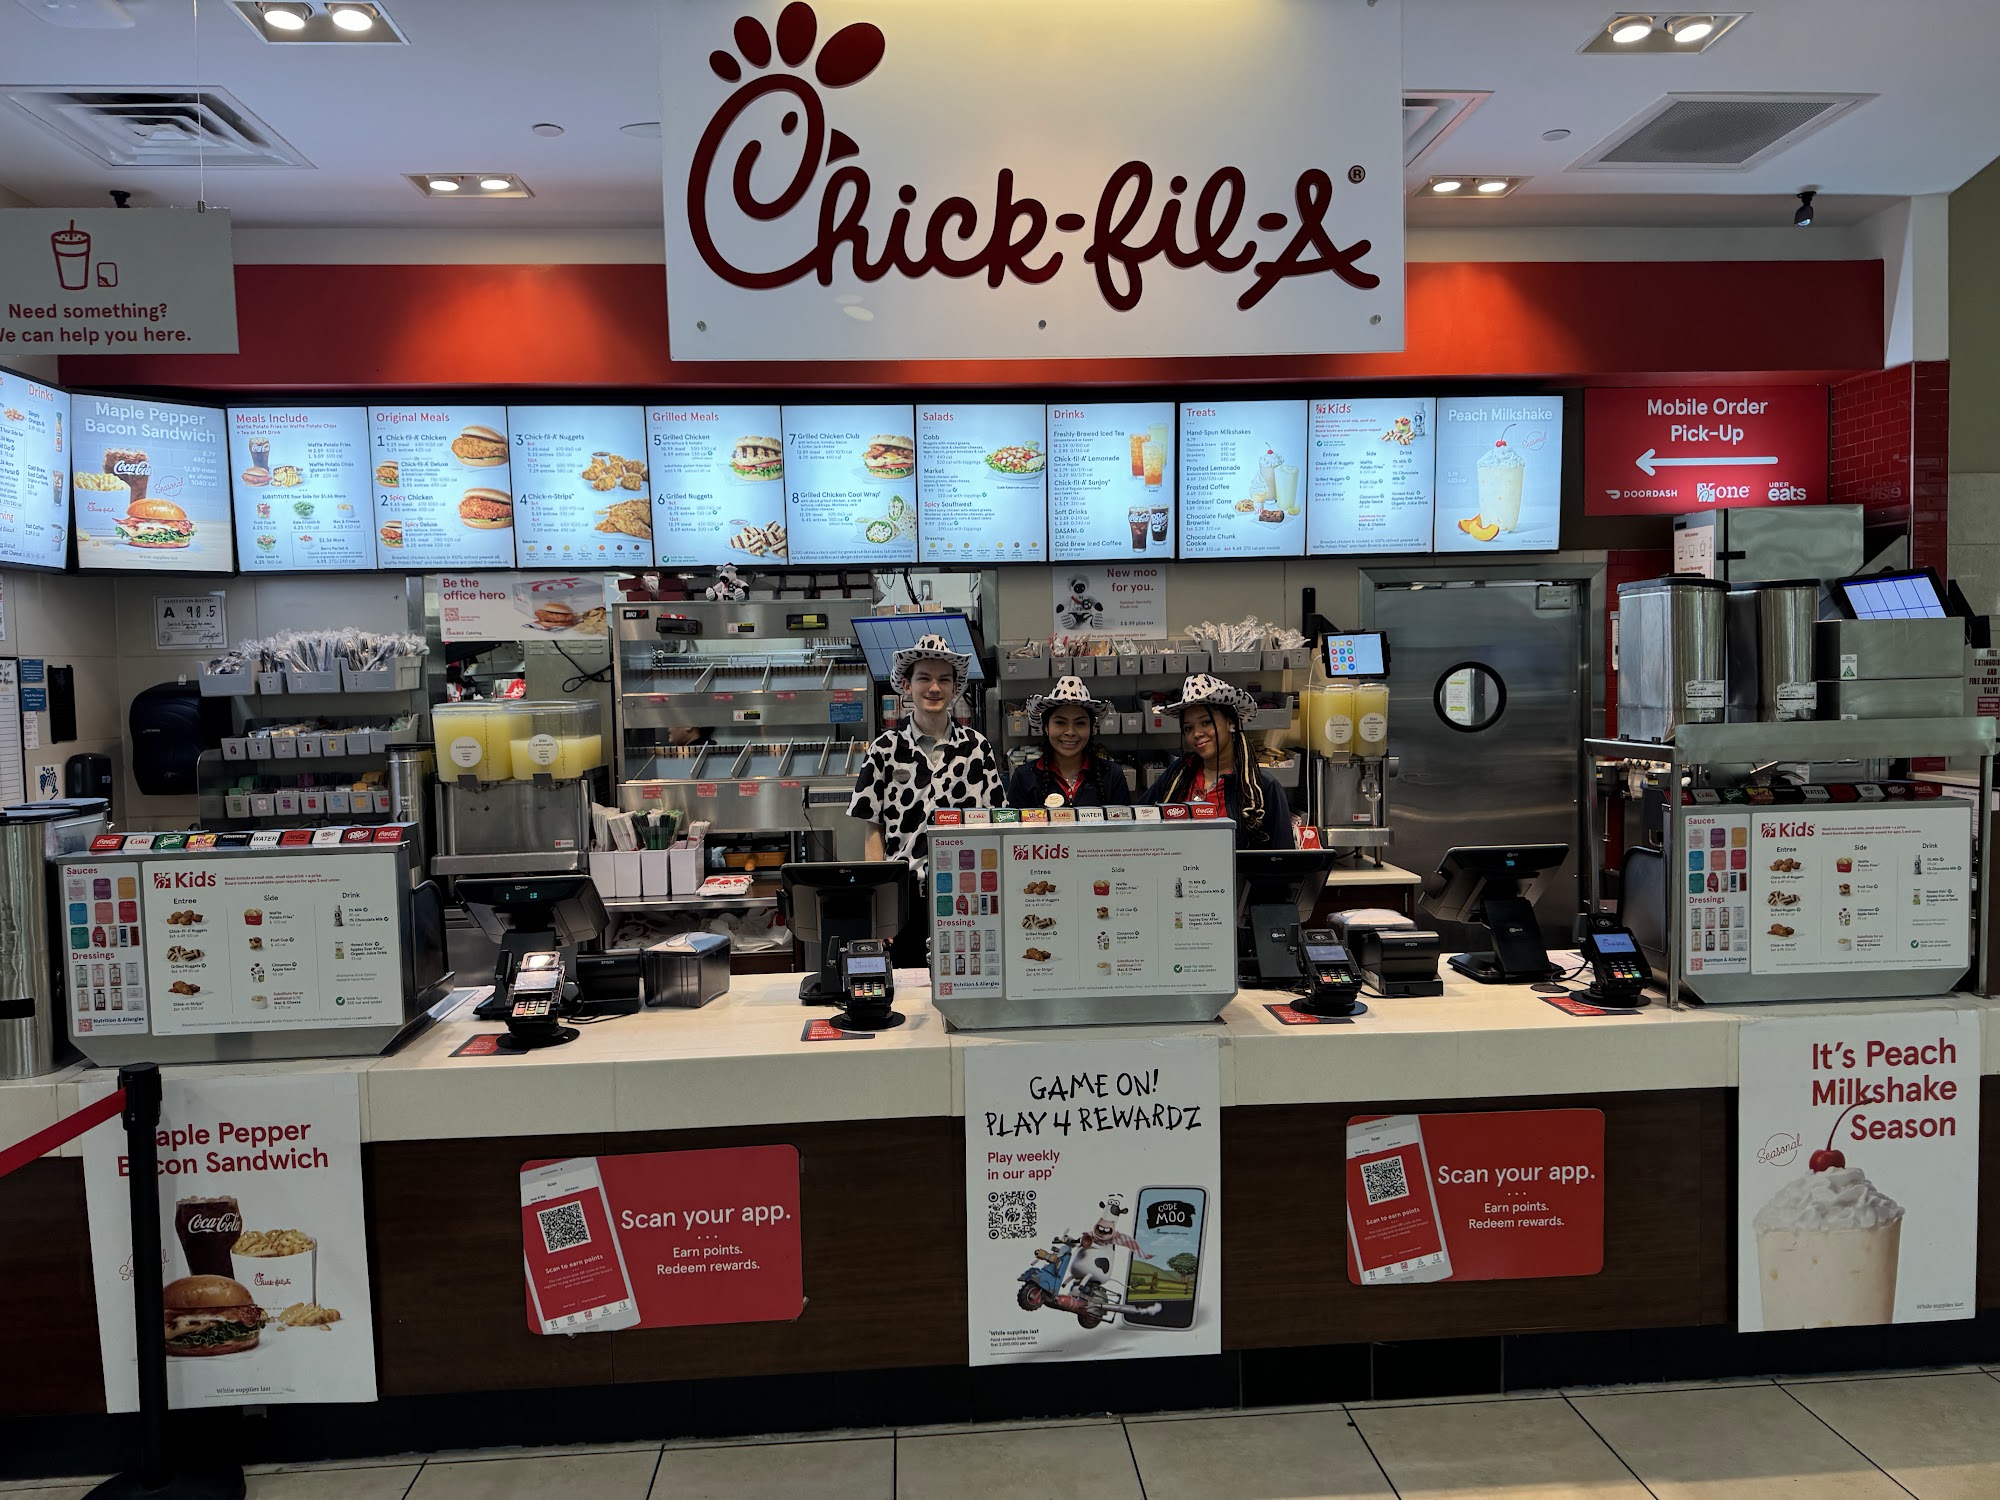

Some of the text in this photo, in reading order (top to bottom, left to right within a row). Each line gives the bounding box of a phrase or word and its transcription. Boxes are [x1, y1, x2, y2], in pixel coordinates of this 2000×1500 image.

[8, 302, 168, 322] Need something?
[21, 329, 54, 342] can
[59, 327, 100, 346] help
[104, 330, 138, 346] you
[143, 326, 192, 342] here.
[28, 383, 54, 402] Drinks
[1186, 408, 1216, 417] Treats
[1327, 403, 1350, 414] Kids
[1647, 397, 1769, 416] Mobile Order
[95, 401, 206, 428] Maple Pepper
[236, 413, 309, 423] Meals Include
[376, 412, 450, 425] Original Meals
[652, 411, 720, 422] Grilled Meals
[922, 411, 954, 421] Salads
[1053, 409, 1085, 419] Drinks
[1448, 407, 1553, 422] Peach Milkshake
[84, 418, 216, 443] Bacon Sandwich
[1053, 430, 1099, 438] Freshly-Brewed
[1219, 428, 1251, 436] Milkshakes
[1670, 423, 1745, 445] Pick-Up
[653, 434, 662, 446] 5
[788, 433, 797, 445] 7
[845, 432, 861, 440] Club
[113, 460, 151, 476] Coca-Cola
[1209, 464, 1241, 472] Lemonade
[791, 492, 800, 504] 8
[800, 491, 821, 499] Grilled
[821, 491, 847, 499] Chicken
[1623, 489, 1678, 499] DOORDASH
[1715, 485, 1749, 499] one
[1767, 485, 1807, 501] eats
[380, 494, 389, 507] 2
[389, 494, 406, 502] Spicy
[519, 493, 528, 506] 4
[657, 493, 666, 506] 6
[688, 493, 713, 501] Nuggets
[1217, 513, 1235, 521] Fudge
[1186, 533, 1236, 541] Chocolate Chunk
[1106, 568, 1158, 578] New moo
[442, 577, 480, 588] Be the
[1111, 582, 1154, 594] for you.
[443, 590, 506, 601] office hero
[163, 606, 176, 618] A
[1688, 816, 1716, 826] Sauces
[1779, 821, 1814, 838] Kids
[129, 837, 151, 846] Coke
[253, 835, 278, 843] WATER
[935, 838, 964, 847] Sauces
[1032, 843, 1069, 860] Kids
[1854, 844, 1868, 852] Side
[66, 866, 98, 876] Sauces
[174, 871, 216, 889] Kids
[173, 897, 197, 905] Entree
[263, 894, 279, 902] Side
[342, 891, 361, 899] Drink
[1688, 895, 1726, 905] Dressings
[936, 918, 976, 928] Dressings
[72, 951, 115, 961] Dressings
[122, 1016, 145, 1024] Allergies
[1811, 1037, 1957, 1070] It's Peach
[1029, 1069, 1160, 1102] GAME ON!
[1811, 1074, 1958, 1107] Milkshake
[986, 1103, 1202, 1137] PLAY 4 REWARDZ
[1849, 1113, 1957, 1141] Season
[156, 1120, 311, 1149] aple Pepper
[1756, 1133, 1803, 1165] Seasonal
[117, 1147, 329, 1177] Bcon Sandwich
[987, 1149, 1061, 1166] Play weekly
[987, 1167, 1000, 1181] in
[1002, 1169, 1025, 1181] our
[1437, 1162, 1596, 1187] Scan your app.
[1158, 1203, 1179, 1213] CODE
[1484, 1200, 1550, 1215] Earn points.
[188, 1212, 240, 1234] Coca-Cola
[621, 1204, 791, 1231] Scan your app.
[1156, 1211, 1186, 1225] MOO
[1468, 1214, 1565, 1230] Redeem rewards.
[672, 1244, 744, 1260] Earn points.
[545, 1265, 560, 1275] Scan
[569, 1260, 583, 1269] earn
[583, 1254, 604, 1267] points
[656, 1259, 761, 1275] Redeem rewards.
